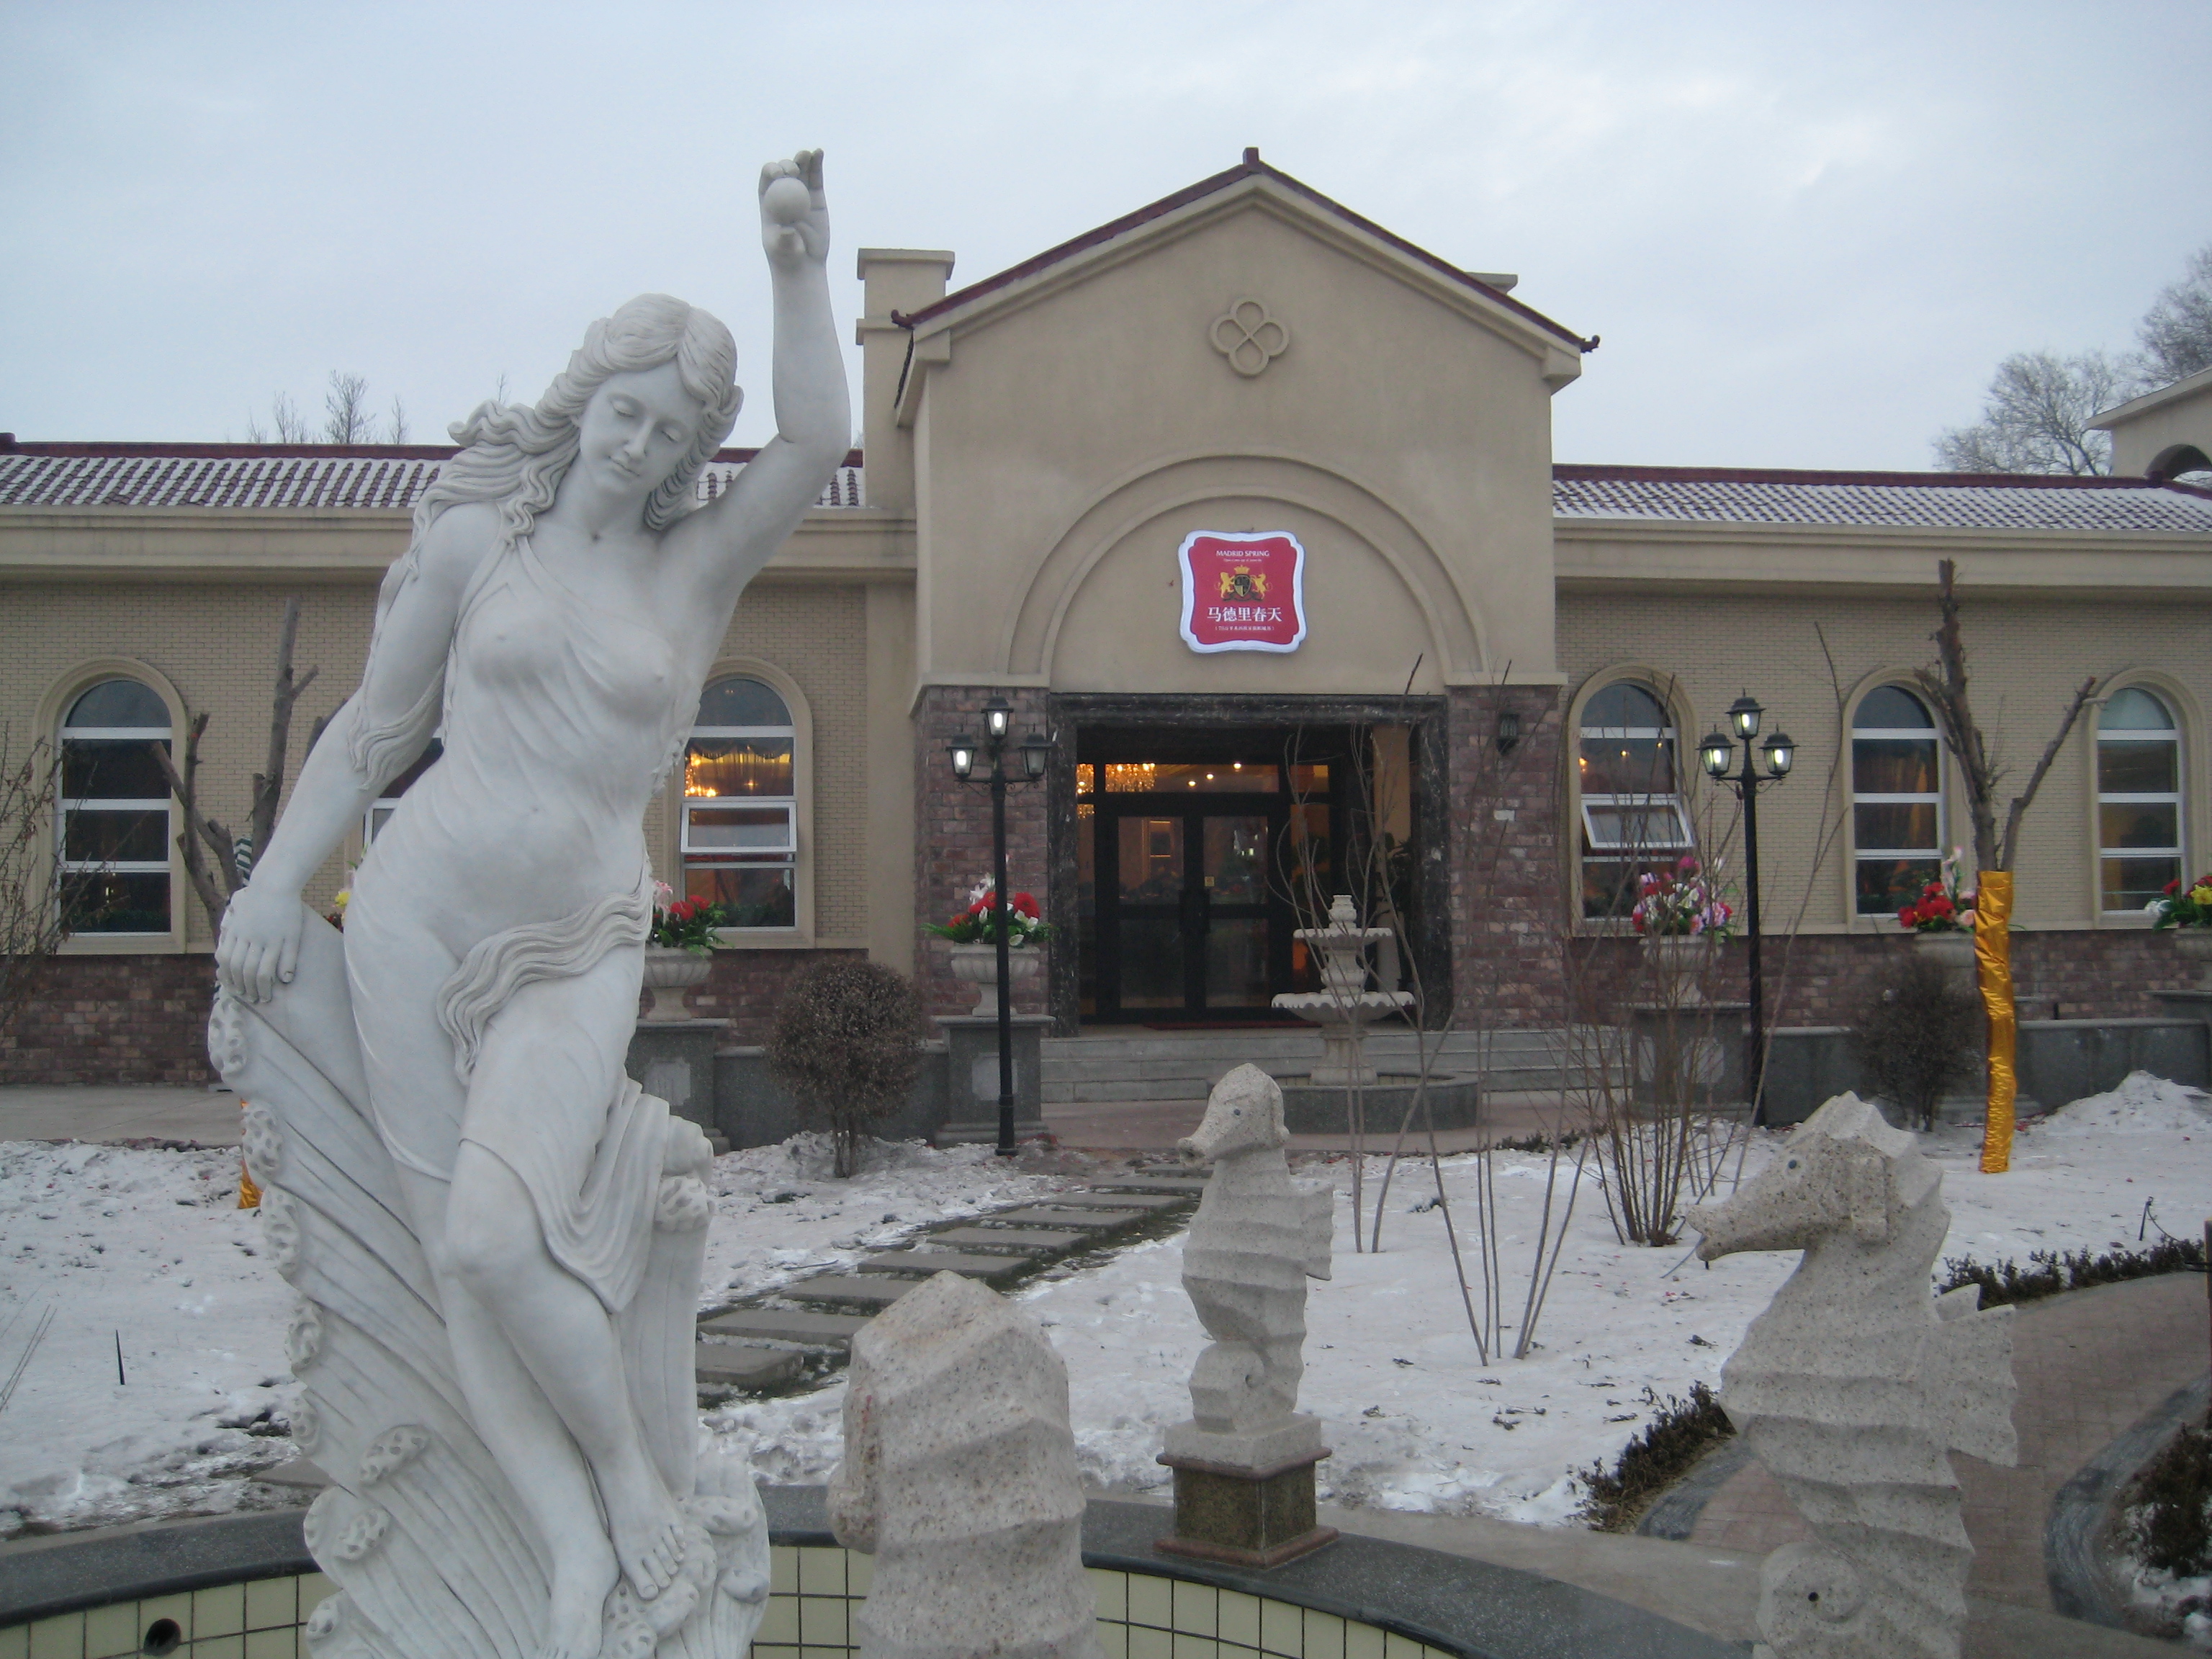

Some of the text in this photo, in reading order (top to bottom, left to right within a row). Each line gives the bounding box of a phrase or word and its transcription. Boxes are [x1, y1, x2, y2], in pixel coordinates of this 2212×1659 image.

[1207, 606, 1282, 622] 马德里春天
